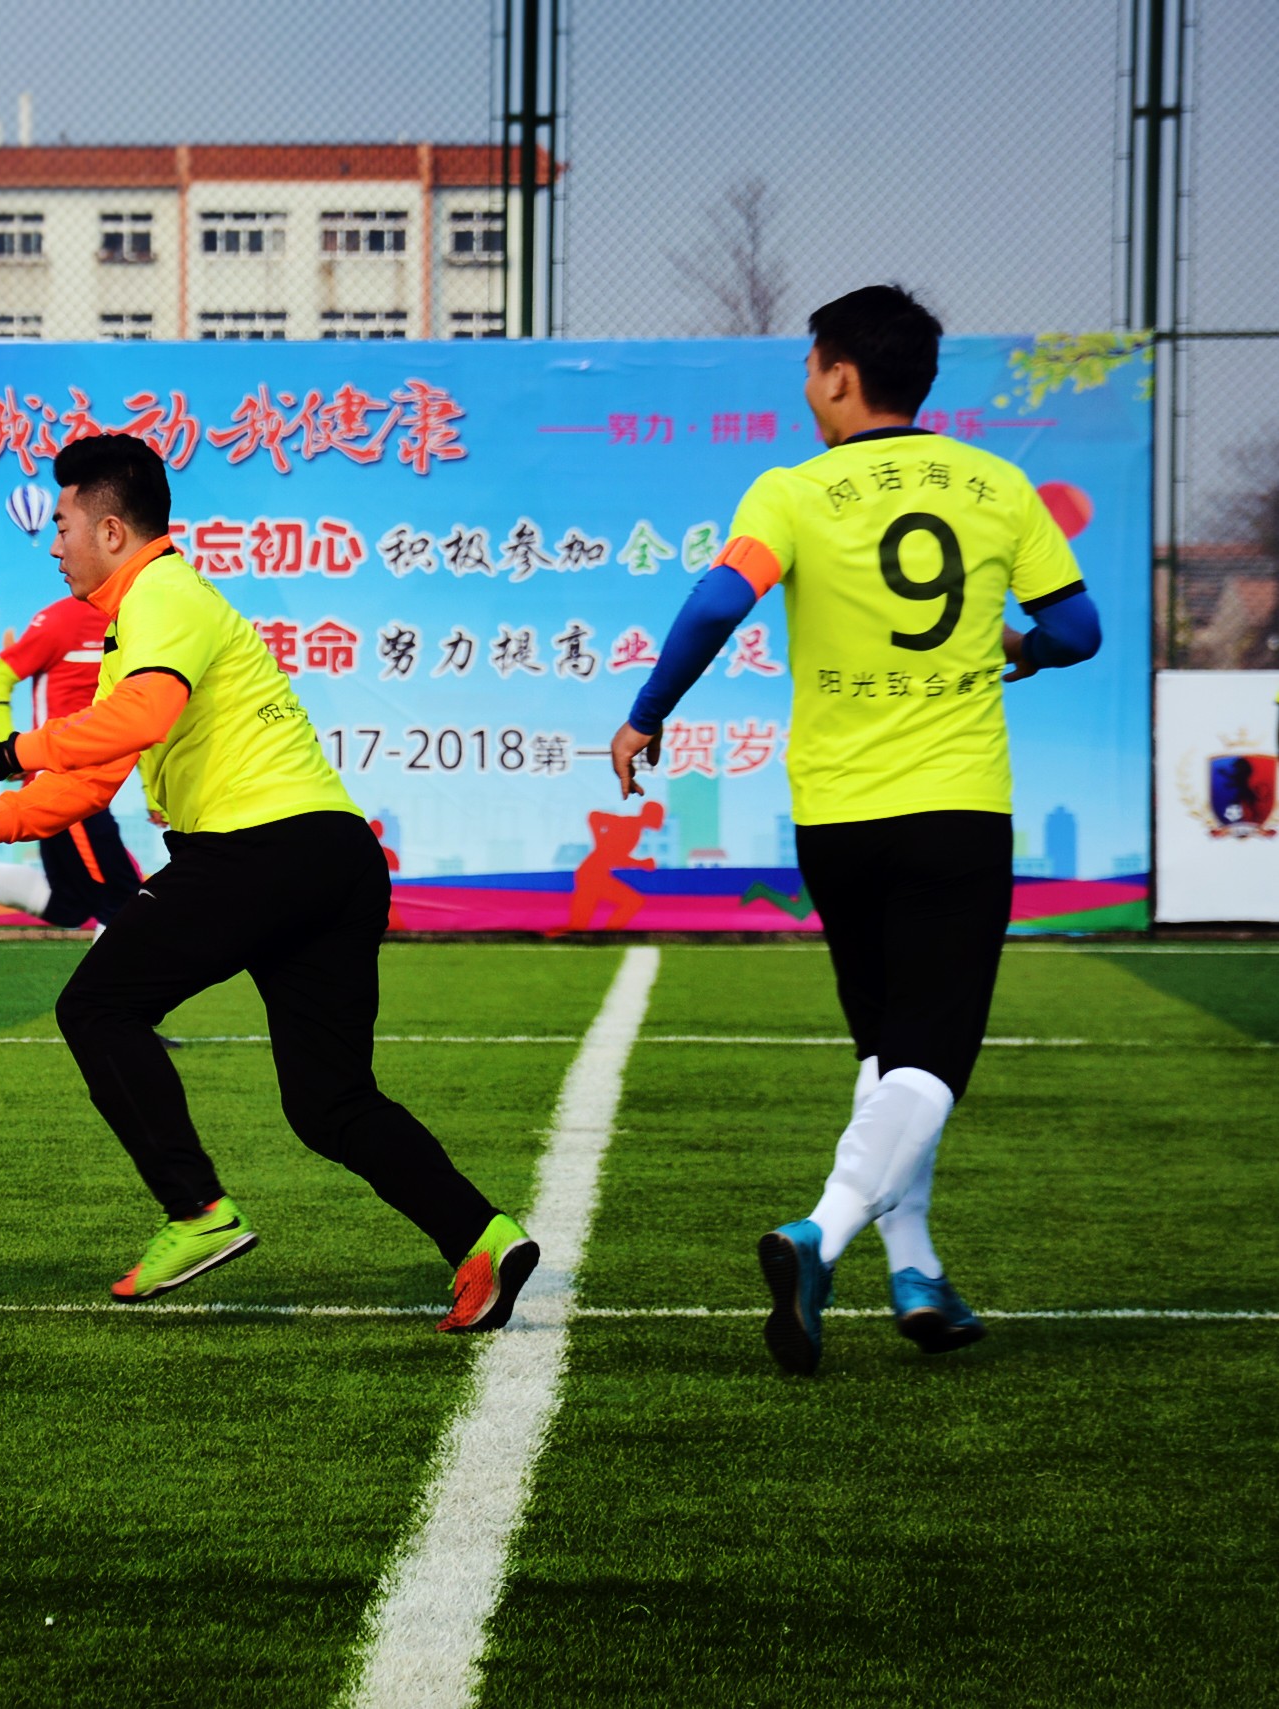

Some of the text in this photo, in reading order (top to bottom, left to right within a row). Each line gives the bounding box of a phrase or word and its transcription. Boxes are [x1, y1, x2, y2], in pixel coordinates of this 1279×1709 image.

[877, 511, 966, 652] 9
[379, 623, 779, 678] 努力提高业足
